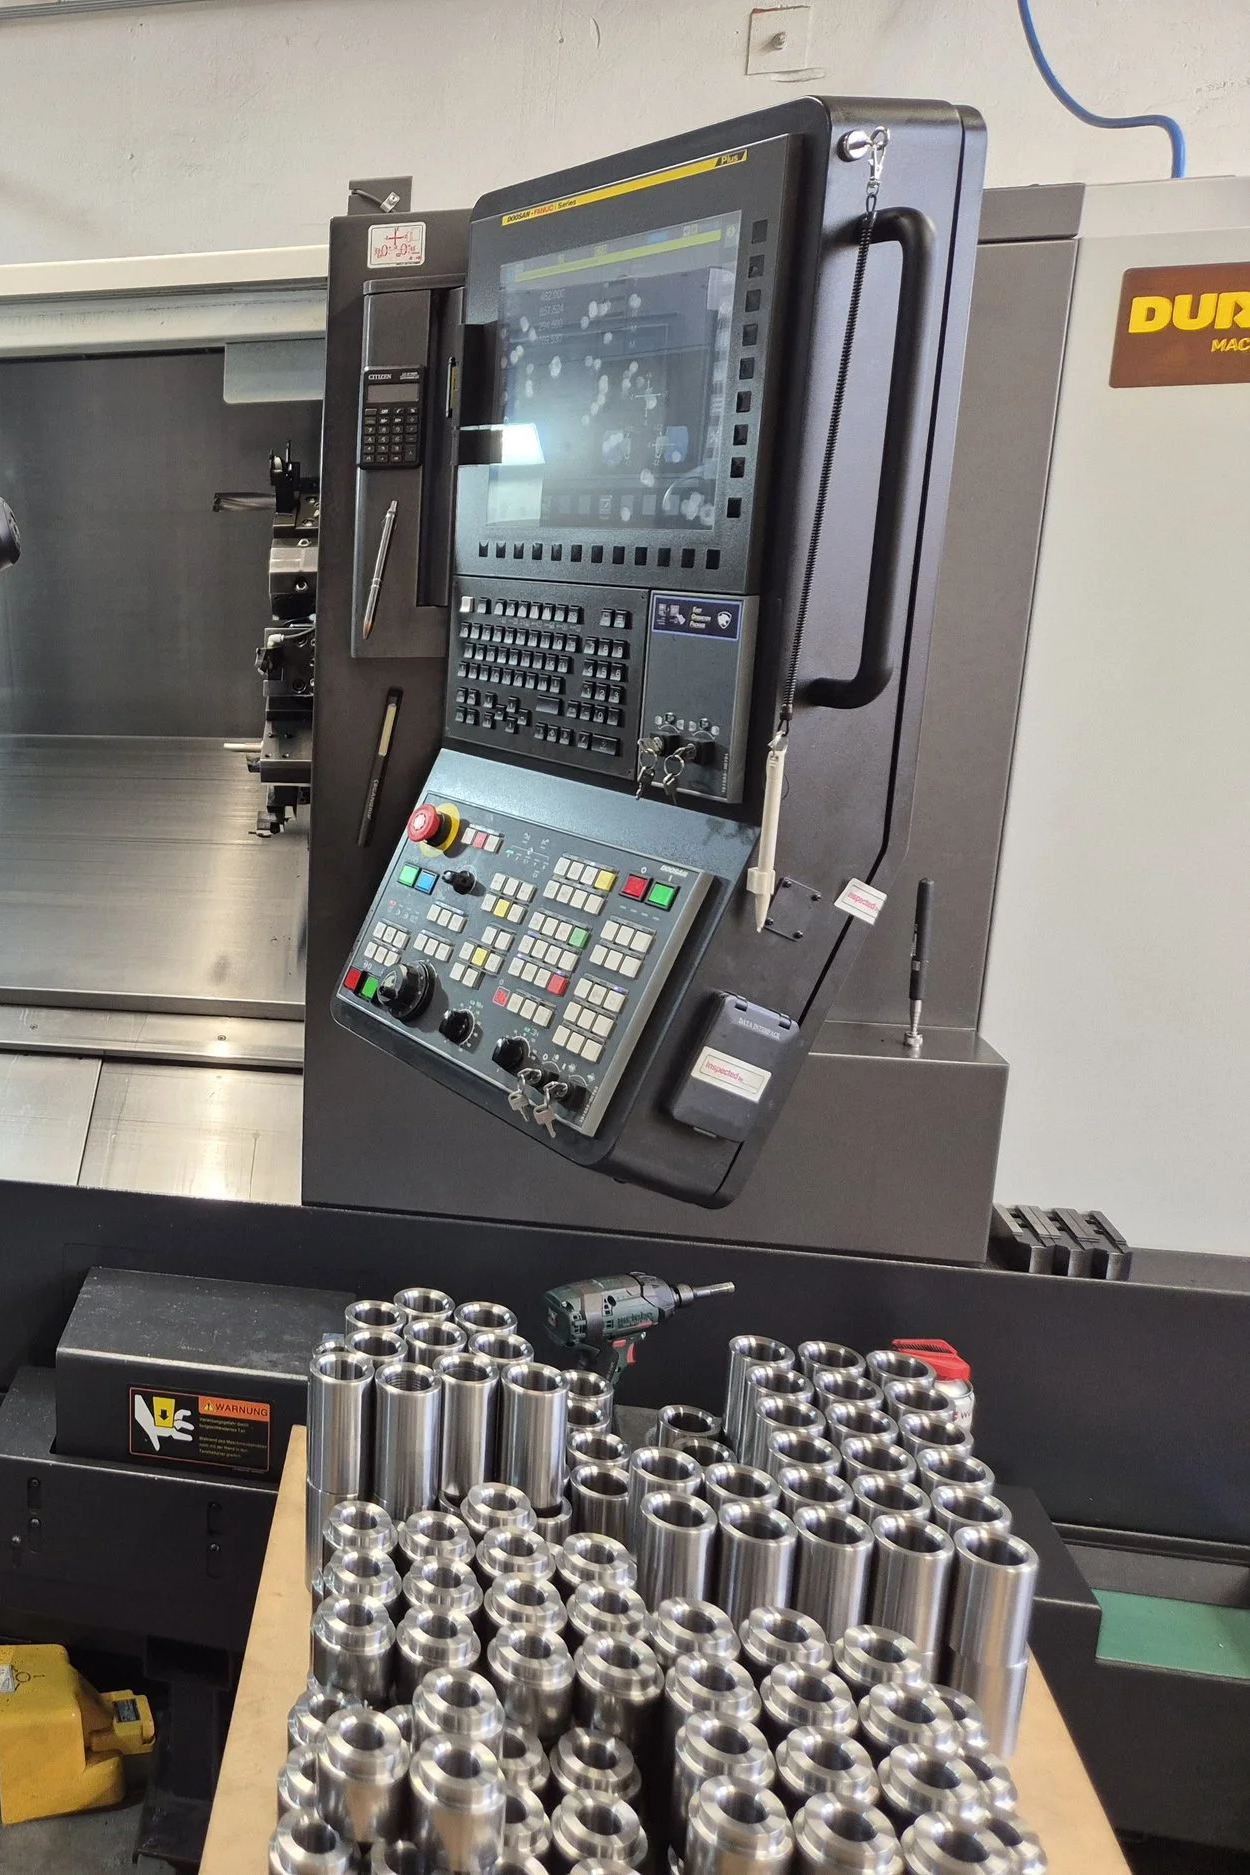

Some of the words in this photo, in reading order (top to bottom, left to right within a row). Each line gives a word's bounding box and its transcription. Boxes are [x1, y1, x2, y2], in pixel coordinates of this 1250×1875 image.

[721, 153, 739, 164] Plus
[507, 210, 530, 223] DOOSAN
[534, 204, 553, 215] FANUC
[558, 199, 577, 209] Series
[660, 864, 689, 878] DOOSAN
[738, 1017, 753, 1030] DATA
[752, 1022, 781, 1040] INTERFACE
[705, 1061, 740, 1081] Inspected
[617, 1311, 653, 1325] metabo
[215, 1403, 268, 1417] WARNUNG
